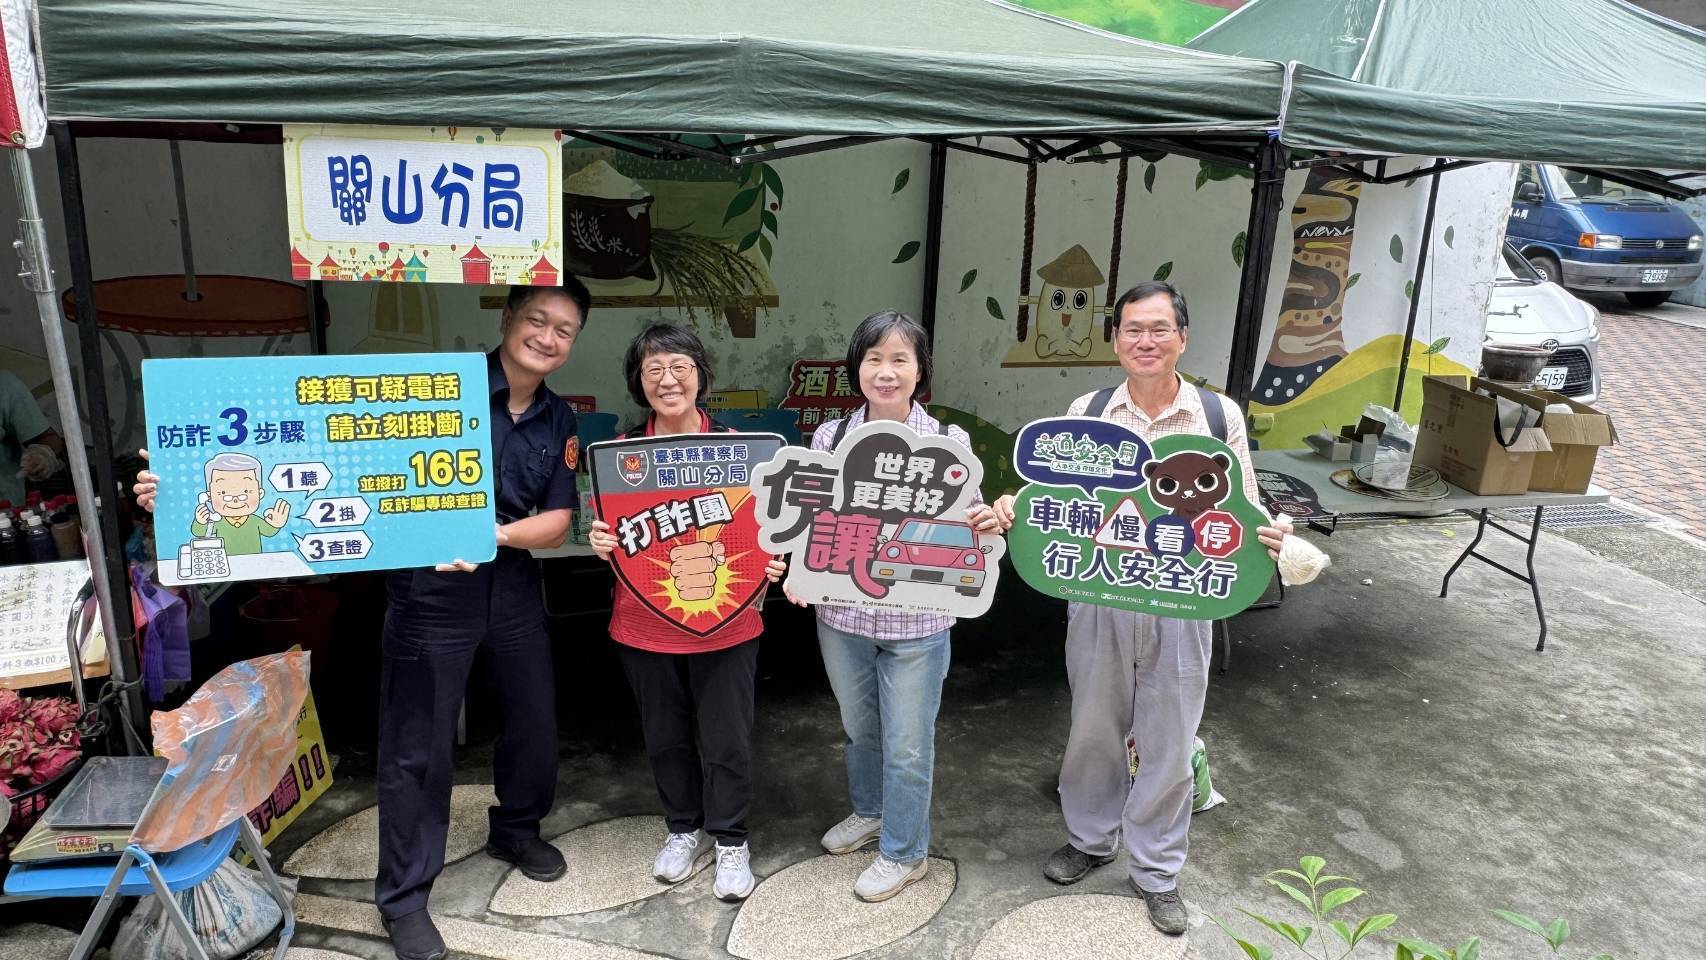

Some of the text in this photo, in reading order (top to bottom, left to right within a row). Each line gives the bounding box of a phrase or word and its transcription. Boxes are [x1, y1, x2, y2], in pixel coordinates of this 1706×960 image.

[327, 154, 524, 232] 關山分局
[297, 374, 460, 404] 接獲可疑電話
[327, 411, 479, 442] 請立刻掛斷,
[654, 444, 748, 464] 臺東縣警察局
[874, 452, 935, 484] 世界
[358, 449, 482, 492] 並撥打 165
[657, 464, 748, 488] 關山分局
[379, 492, 487, 513] 反詐騙專線查證
[850, 481, 944, 515] 更美好
[617, 492, 733, 556] 打詐團
[1043, 541, 1237, 598] 行人安全行
